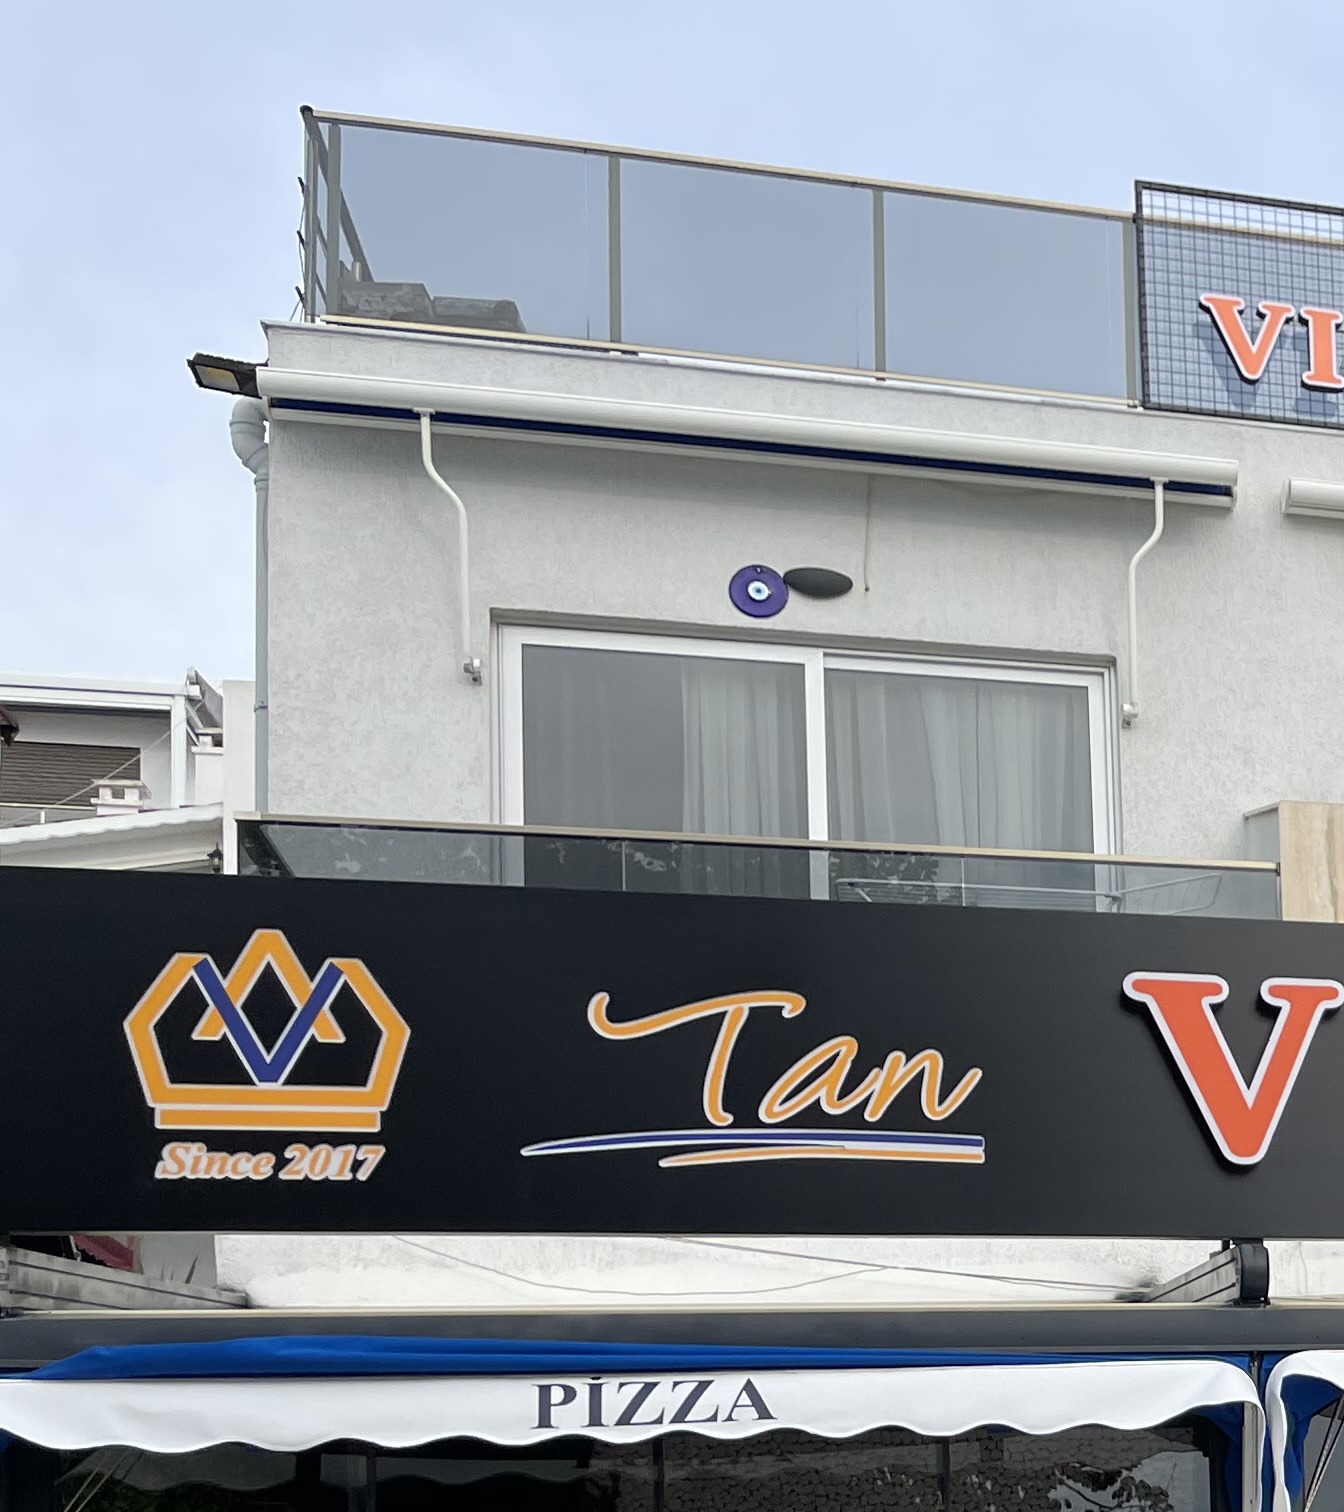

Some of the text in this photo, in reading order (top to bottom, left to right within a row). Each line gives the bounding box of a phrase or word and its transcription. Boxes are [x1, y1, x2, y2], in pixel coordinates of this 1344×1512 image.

[588, 990, 983, 1126] Tan
[154, 1141, 388, 1182] Since 2017
